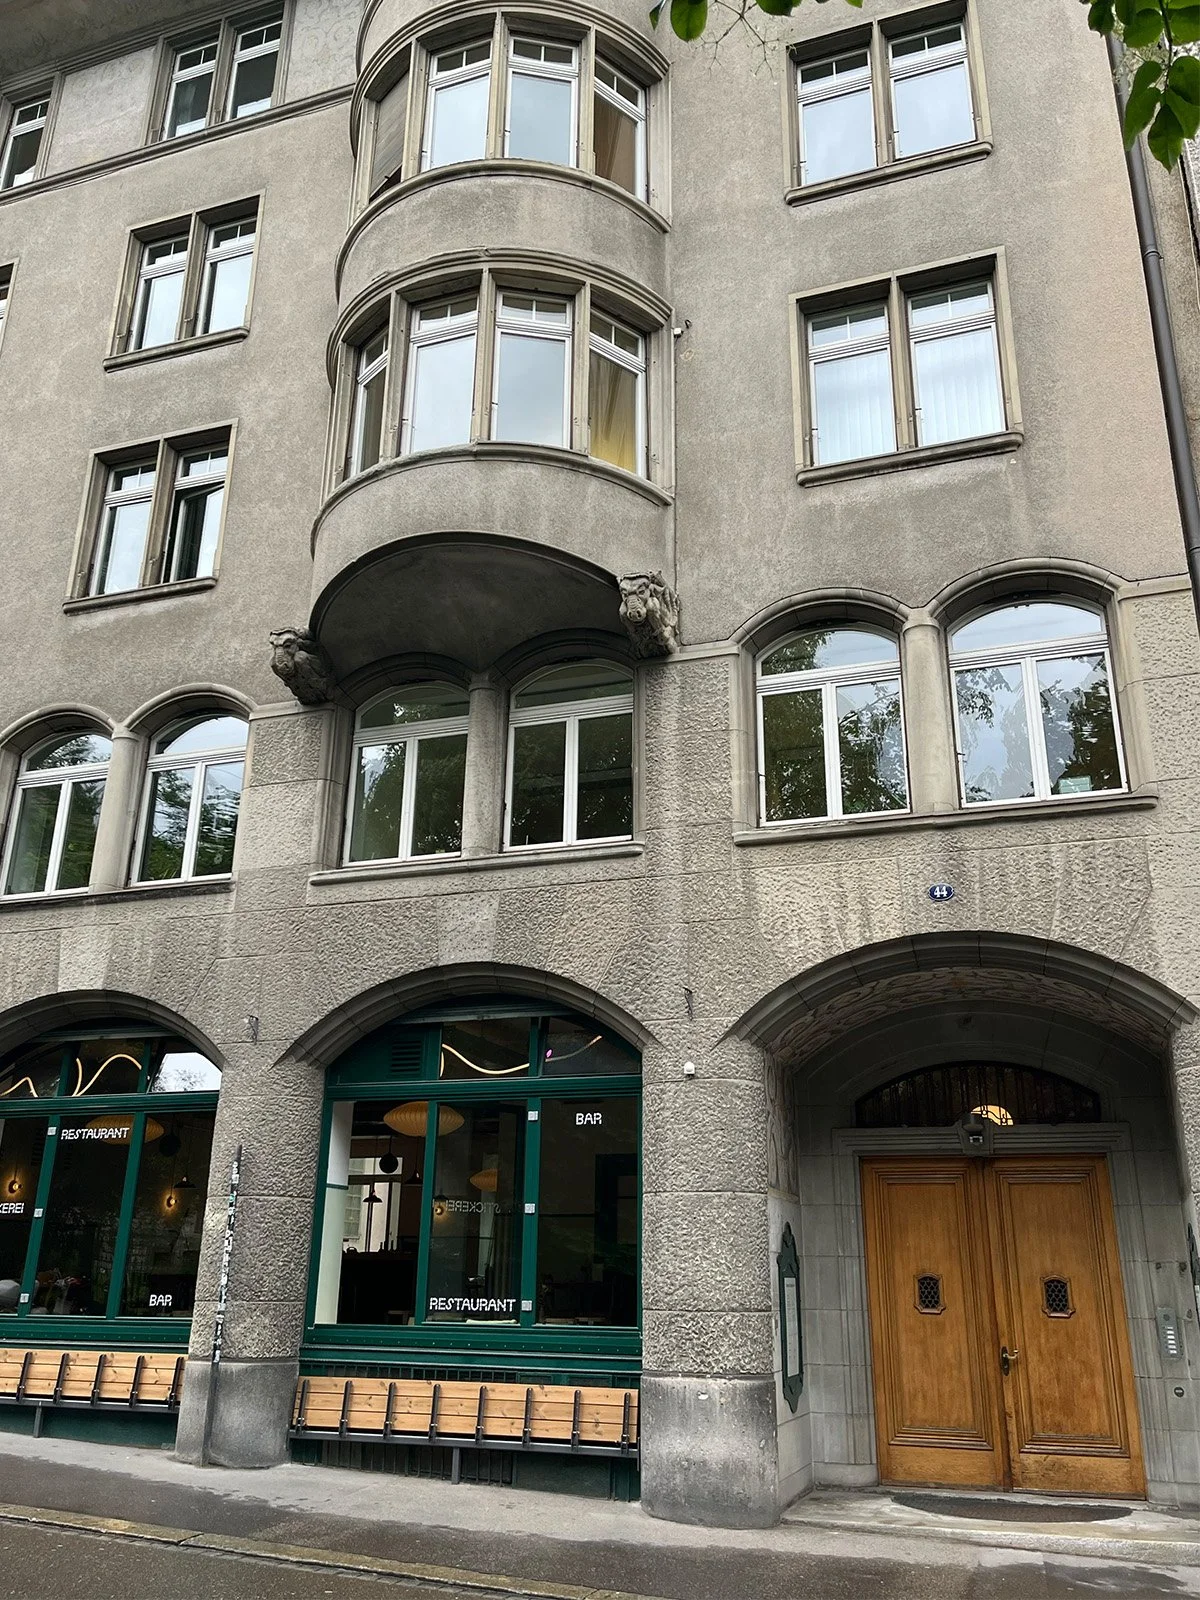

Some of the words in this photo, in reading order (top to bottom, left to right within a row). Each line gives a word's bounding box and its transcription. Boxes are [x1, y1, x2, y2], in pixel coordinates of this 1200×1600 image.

[934, 885, 948, 898] 44
[575, 1112, 602, 1126] BAR
[60, 1127, 130, 1140] RESTAURANT
[149, 1294, 173, 1307] BAR
[429, 1297, 517, 1312] RESTAURANT
